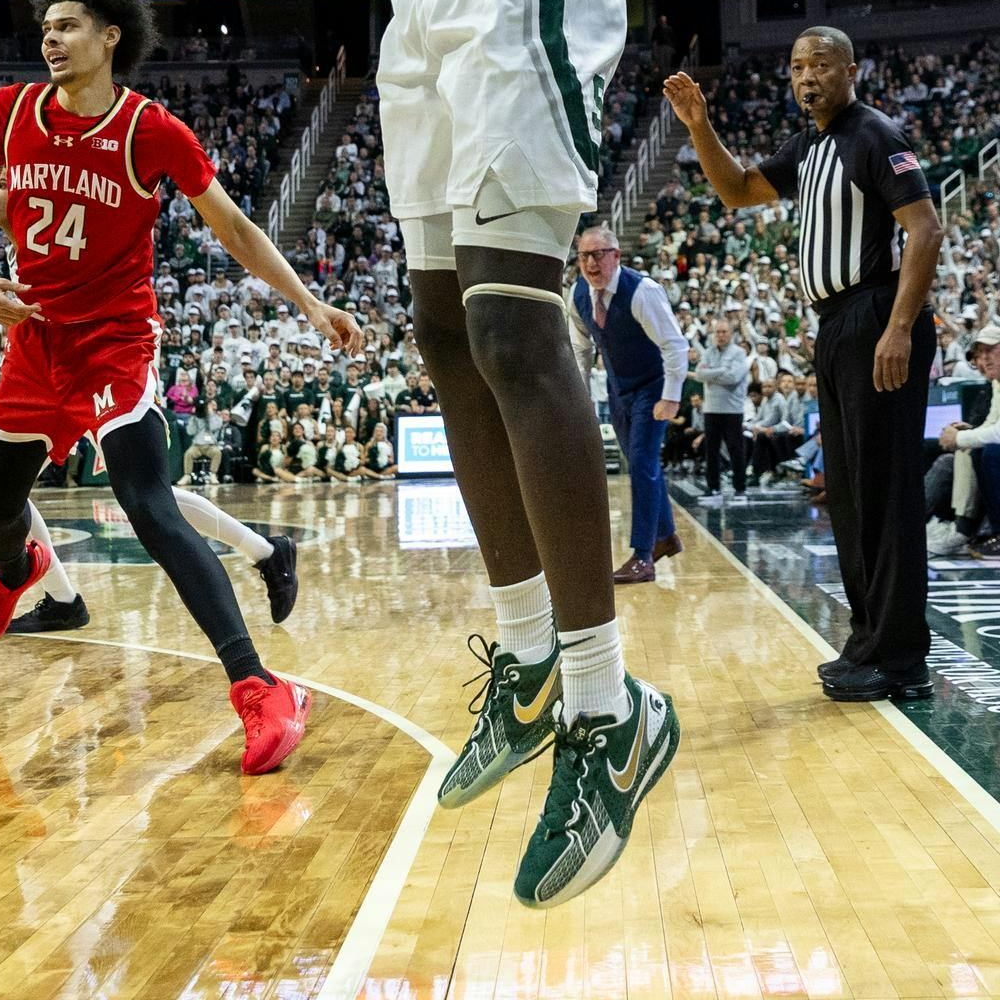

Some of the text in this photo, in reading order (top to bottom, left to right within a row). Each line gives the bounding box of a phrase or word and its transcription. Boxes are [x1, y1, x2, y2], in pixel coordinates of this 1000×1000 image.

[9, 163, 122, 208] MARYLAND
[26, 196, 87, 261] 24
[92, 383, 116, 418] M
